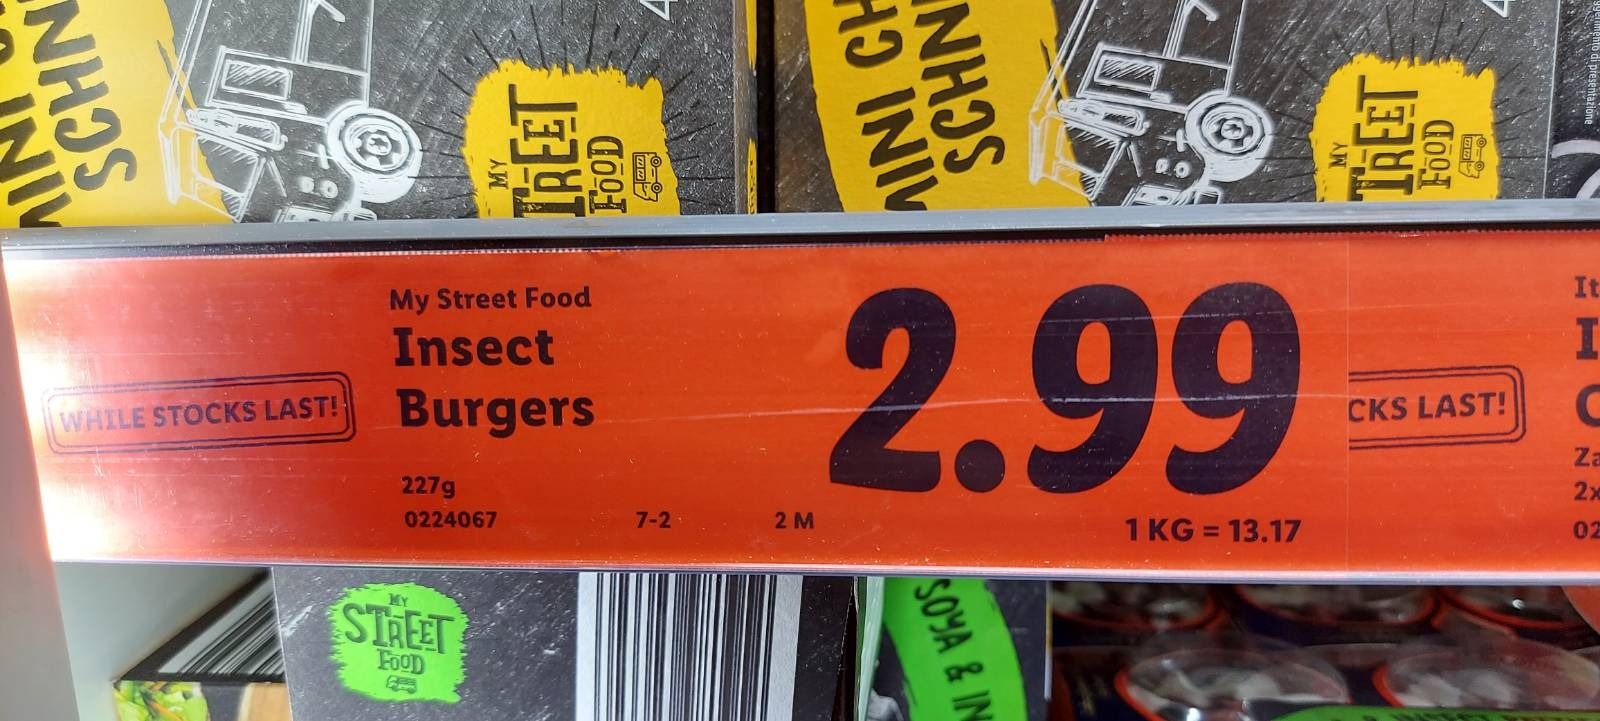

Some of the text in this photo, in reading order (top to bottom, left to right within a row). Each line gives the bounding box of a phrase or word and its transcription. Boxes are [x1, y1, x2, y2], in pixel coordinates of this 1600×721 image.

[1591, 53, 1600, 62] di
[17, 0, 137, 191] SCHN
[911, 0, 1005, 173] SCHN
[1585, 64, 1598, 125] presentazione
[1329, 142, 1348, 169] MY
[1417, 120, 1454, 190] FOOD
[488, 159, 508, 190] MY
[587, 136, 627, 213] FOOD
[390, 286, 592, 315] My Street Food
[393, 327, 554, 367] Insect
[829, 282, 1301, 495] 2.99
[59, 395, 338, 433] WHILE STOCKS LAST!
[396, 388, 595, 438] Burgers
[1348, 392, 1505, 423] CKS LAST!
[401, 475, 456, 499] 227g
[404, 510, 498, 529] 0224067
[635, 510, 671, 529] 7-2
[774, 511, 814, 529] 2 M
[1126, 518, 1302, 542] 1 KG = 13.17
[389, 593, 408, 607] MY
[342, 603, 455, 654] STREET
[914, 579, 972, 654] SOYA
[944, 662, 984, 682] &
[377, 648, 425, 675] FOOD
